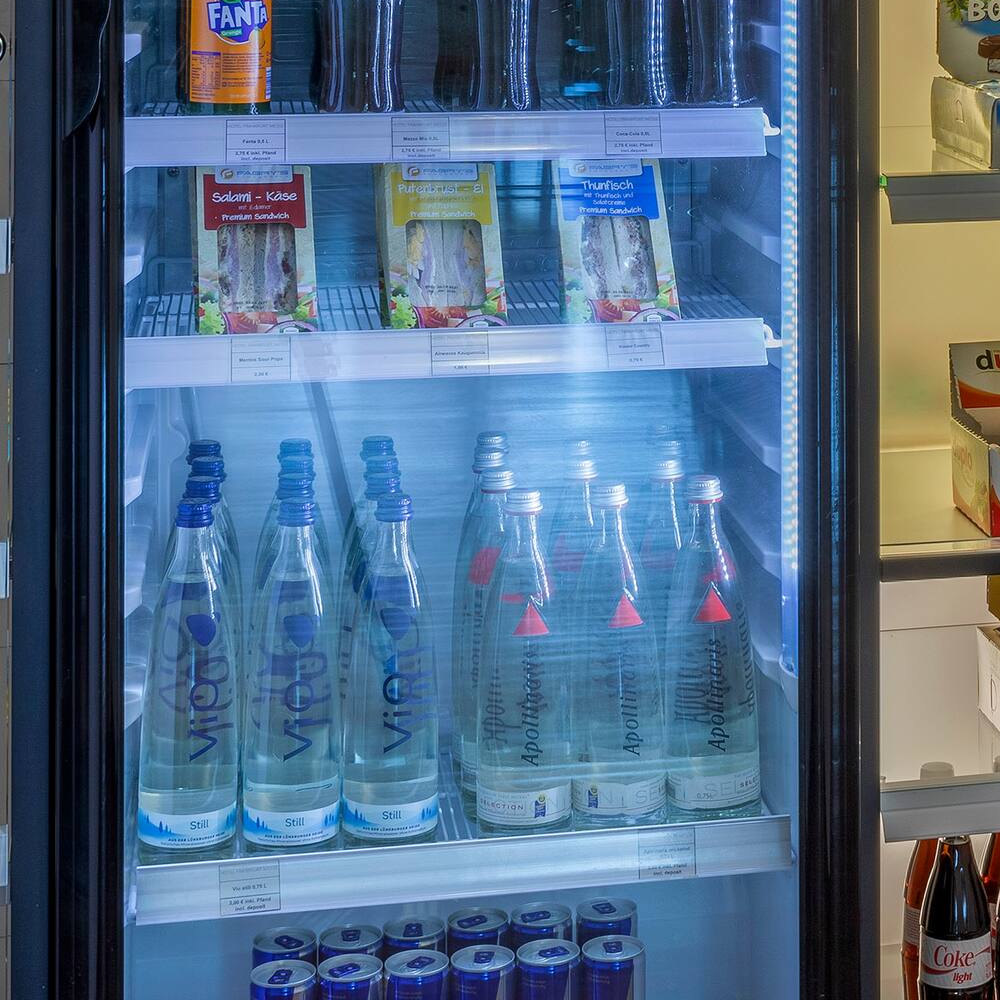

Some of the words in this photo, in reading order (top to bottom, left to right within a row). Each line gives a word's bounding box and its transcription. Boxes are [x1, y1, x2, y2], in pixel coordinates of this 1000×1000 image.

[207, 0, 269, 29] FANTA
[581, 180, 634, 191] Thunfisch
[212, 190, 252, 203] Salami
[266, 190, 298, 202] Käse
[222, 213, 252, 221] Premium
[254, 211, 290, 220] Sandwich
[579, 206, 608, 214] Premium
[609, 206, 643, 215] Sandwich
[382, 810, 402, 820] Still
[190, 819, 209, 831] Still
[285, 817, 305, 828] Still
[933, 944, 977, 968] Coke
[952, 971, 973, 984] light
